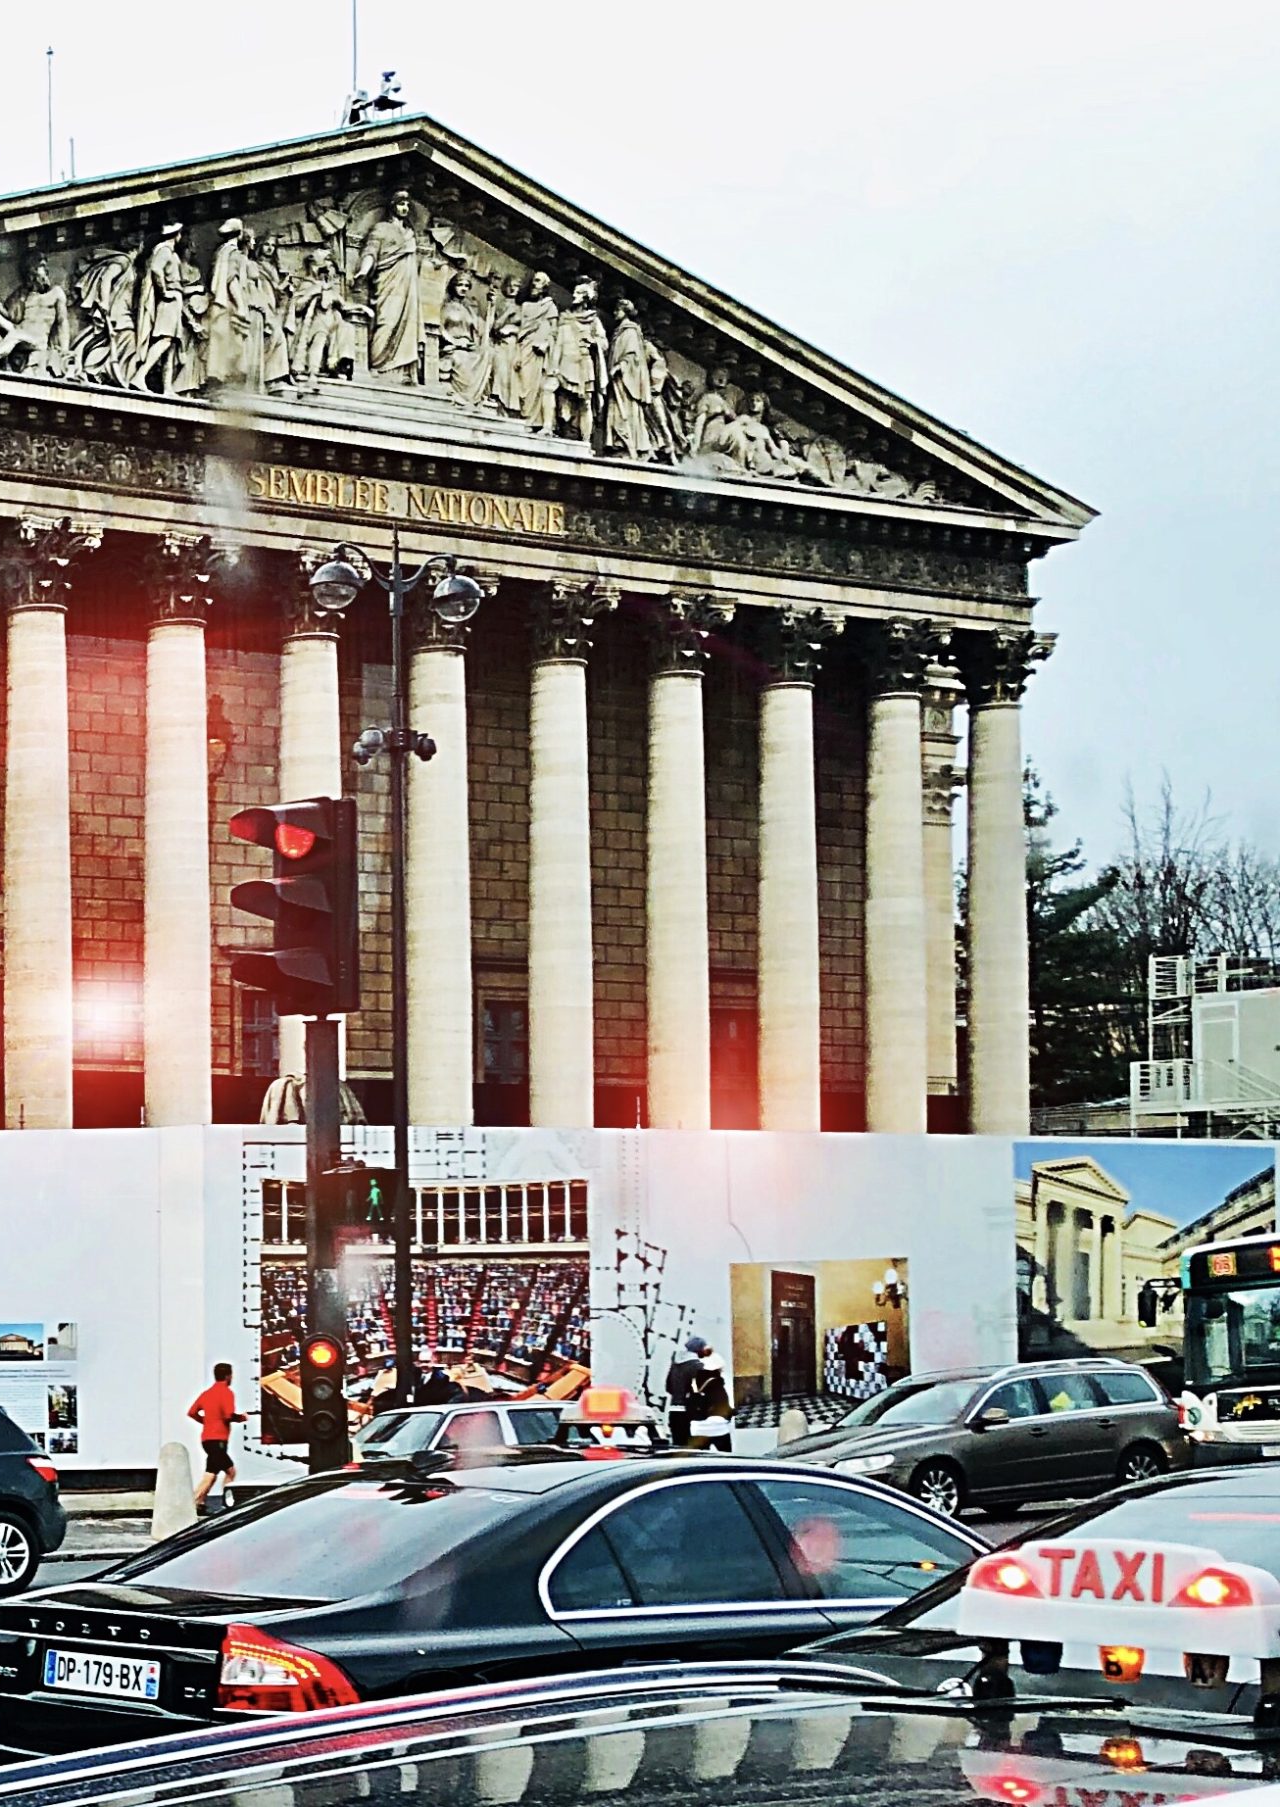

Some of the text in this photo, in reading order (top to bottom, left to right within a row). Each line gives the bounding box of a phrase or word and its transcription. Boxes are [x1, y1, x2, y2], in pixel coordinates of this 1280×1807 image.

[246, 458, 566, 537] SEMBLÉE NATIONALE
[1038, 1548, 1164, 1603] TAXI
[28, 1617, 151, 1640] VOLVO
[56, 1656, 143, 1691] DP-179-BX
